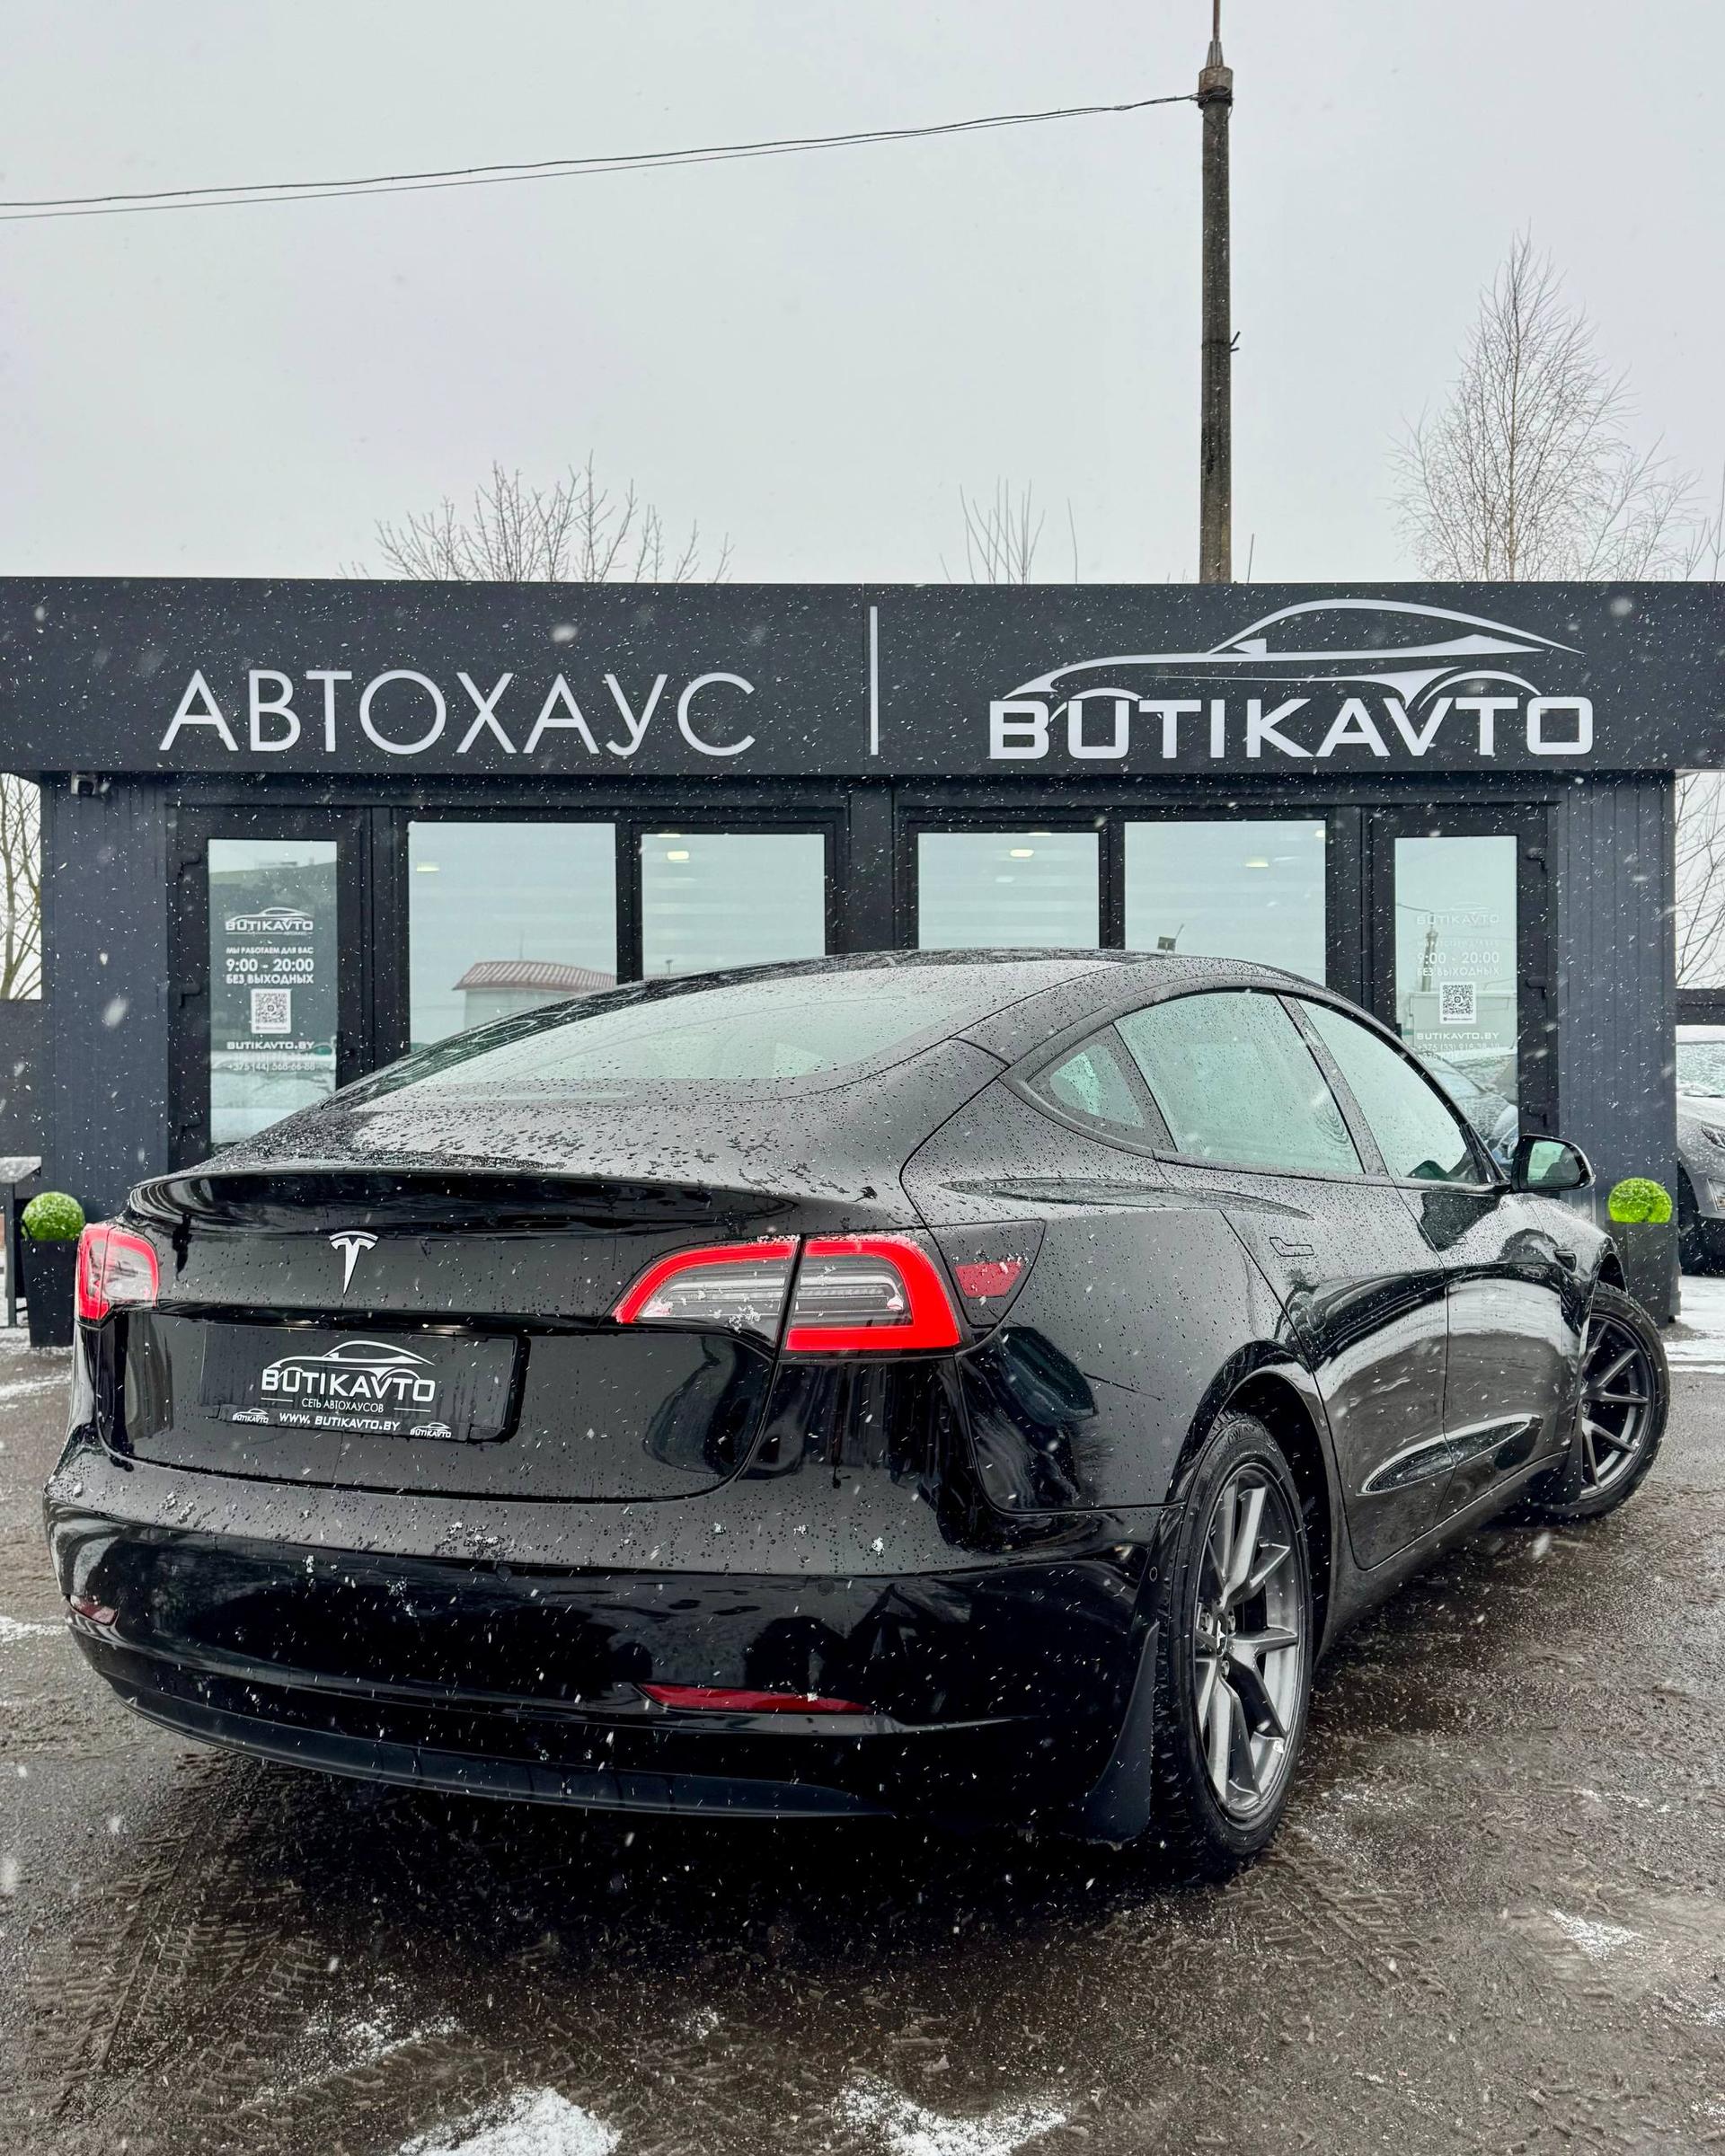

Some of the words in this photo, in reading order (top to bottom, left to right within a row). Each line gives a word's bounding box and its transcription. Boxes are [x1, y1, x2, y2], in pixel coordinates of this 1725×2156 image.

[159, 668, 756, 757] АВТОХАУС
[989, 695, 1594, 760] BUTIKAVTO
[226, 920, 314, 931] BUTIKAVTO
[1416, 914, 1499, 925] BUTIKAVTO
[241, 946, 280, 954] РАБОТАЕМ
[297, 946, 314, 954] ВАС
[1417, 952, 1446, 964] 9:00
[1461, 951, 1499, 964] 20:00
[226, 958, 259, 972] 9:00
[272, 958, 314, 972] 20:00
[226, 973, 245, 985] БЕЗ
[246, 973, 314, 985] ВЫХОДНЫХ
[1416, 1032, 1499, 1040] BUTIKAVTO.BY
[226, 1040, 315, 1049] BUTIKAVTO.BY
[261, 1368, 436, 1401] BUTIKAVTO
[302, 1398, 322, 1409] СЕТЬ
[323, 1400, 385, 1413] АВТОХАУСОВ
[233, 1413, 269, 1424] BUTIKAVTO
[314, 1416, 401, 1431] BUTIKAVTO.BY
[410, 1427, 452, 1438] BUTIKAVTO
